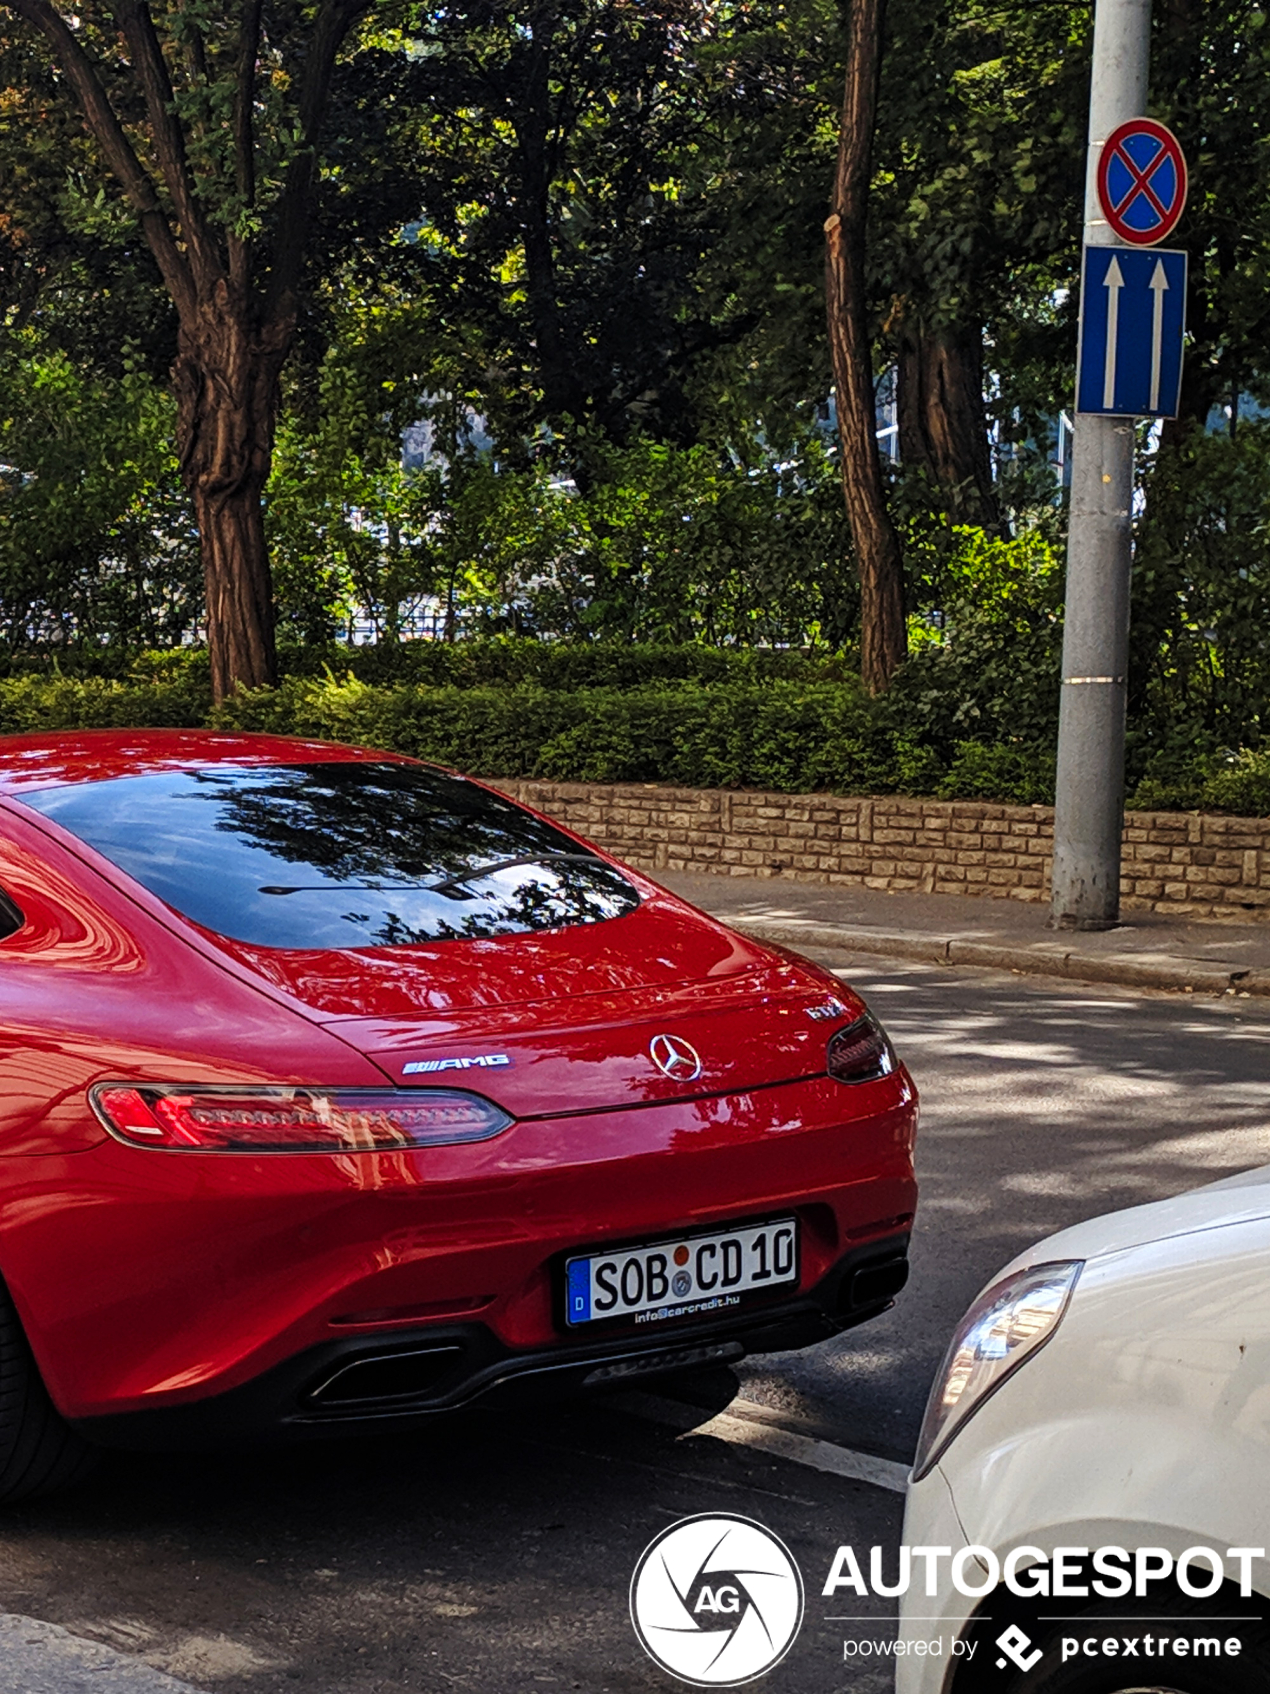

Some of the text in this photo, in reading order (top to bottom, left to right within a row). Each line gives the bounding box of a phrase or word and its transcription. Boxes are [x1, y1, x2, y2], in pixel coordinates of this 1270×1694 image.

[439, 1054, 509, 1071] AMG
[594, 1229, 793, 1310] SOB CD 10
[575, 1297, 584, 1310] D
